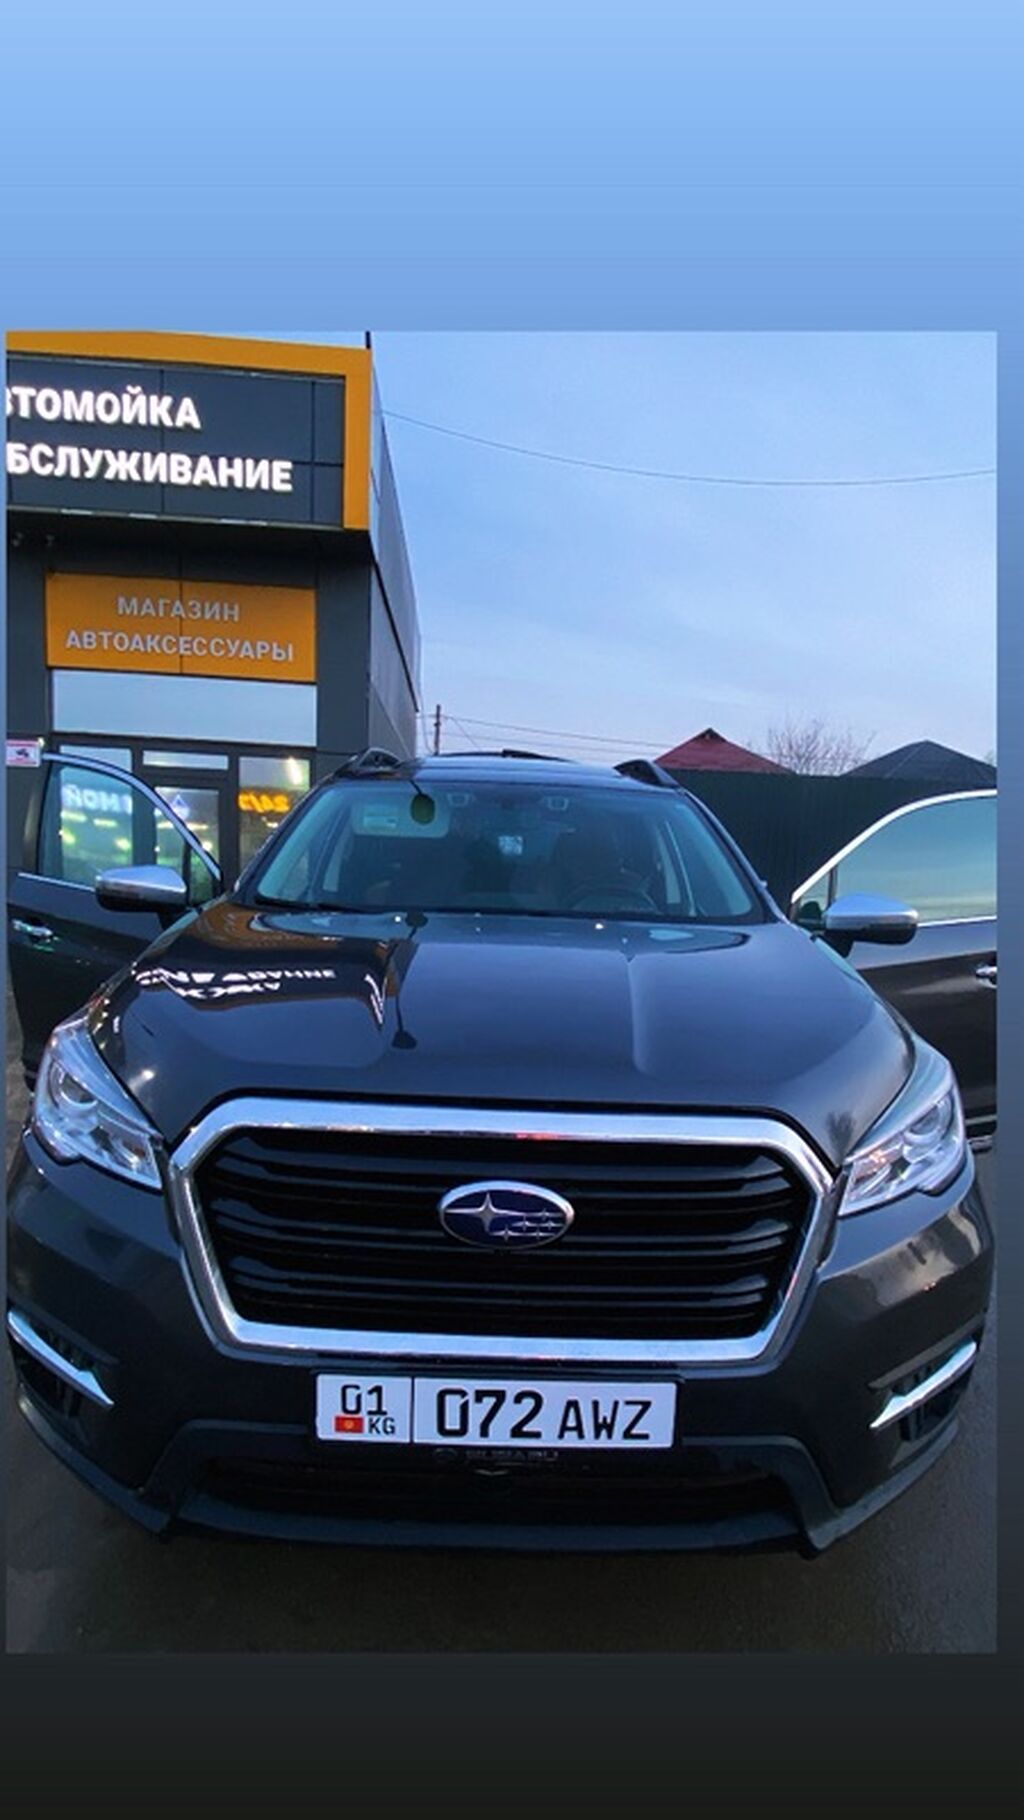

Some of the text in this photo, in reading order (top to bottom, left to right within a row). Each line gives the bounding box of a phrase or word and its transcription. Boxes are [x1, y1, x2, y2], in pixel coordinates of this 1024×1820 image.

[117, 596, 239, 622] МАГАЗИН
[65, 629, 294, 662] АВТОАКСЕССУАРЫ
[341, 1384, 387, 1416] 01
[436, 1387, 652, 1440] 072 AWZ
[368, 1416, 396, 1435] KG
